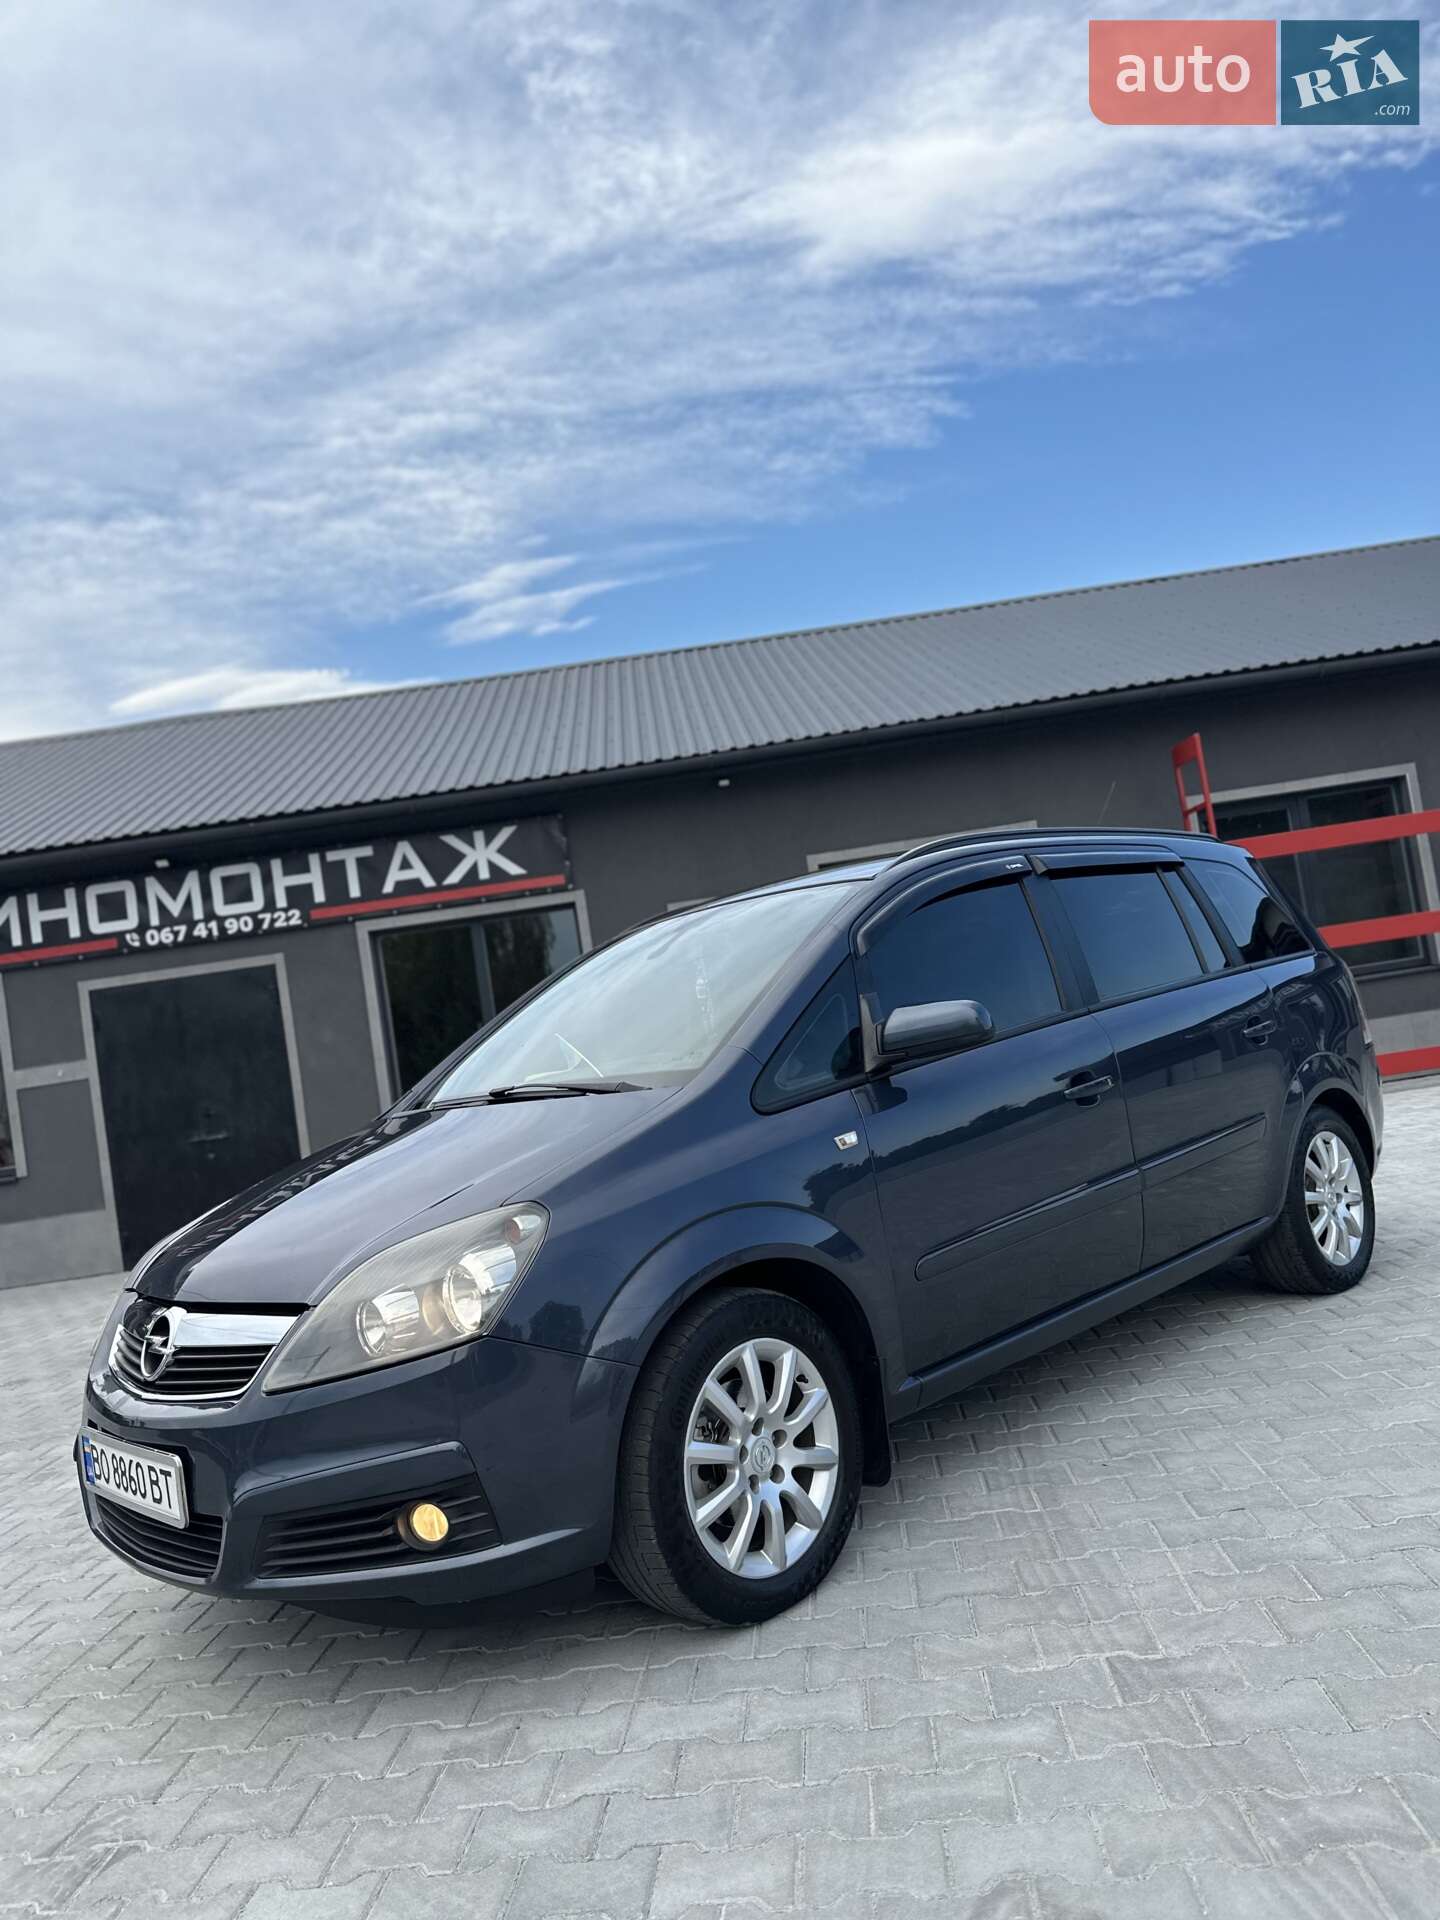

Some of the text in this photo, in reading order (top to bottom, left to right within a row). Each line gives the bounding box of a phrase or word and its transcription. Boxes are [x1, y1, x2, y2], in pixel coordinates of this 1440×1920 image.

[145, 908, 303, 946] 067 41 90 722
[90, 1443, 172, 1510] BO 8860 BT
